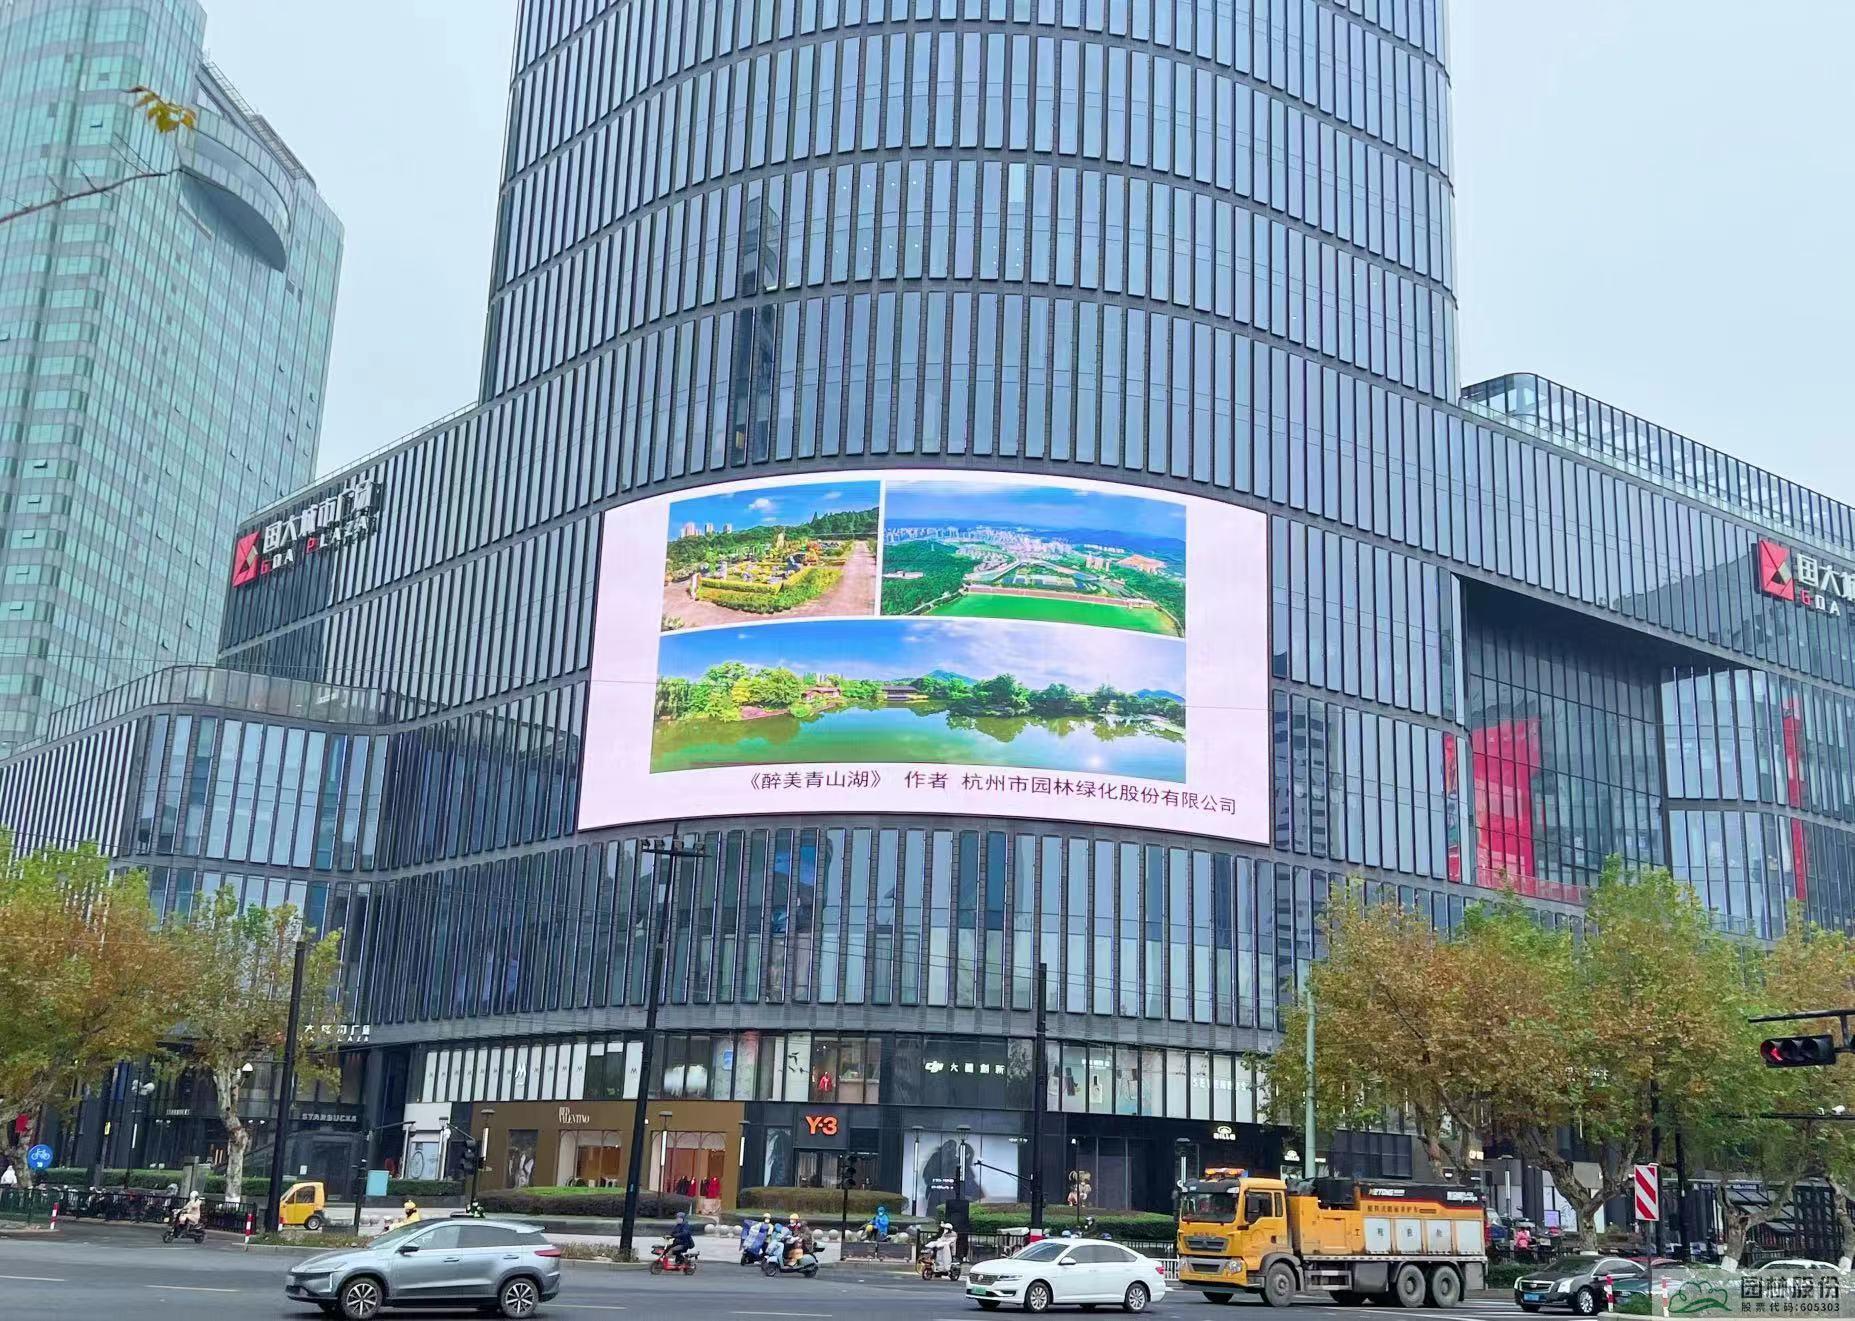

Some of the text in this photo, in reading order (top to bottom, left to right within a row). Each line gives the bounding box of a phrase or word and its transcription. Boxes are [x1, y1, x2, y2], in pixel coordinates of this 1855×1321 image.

[306, 516, 369, 553] PLAZA
[1800, 589, 1840, 616] GDA
[749, 770, 1236, 816] 《醉美青山湖》 作者 杭州市园林绿化股份有限公司
[302, 1113, 357, 1122] STARBUCKS
